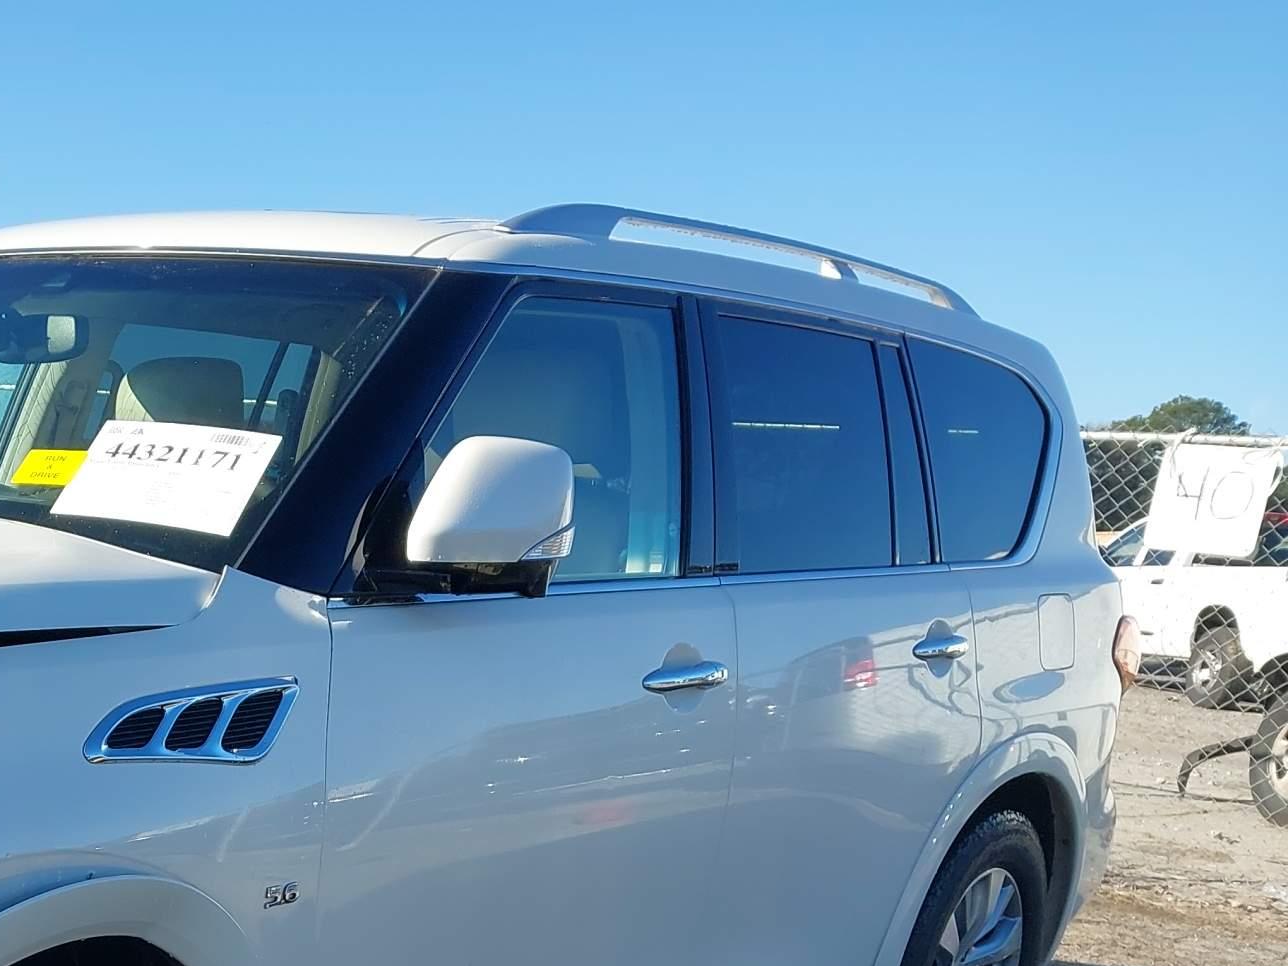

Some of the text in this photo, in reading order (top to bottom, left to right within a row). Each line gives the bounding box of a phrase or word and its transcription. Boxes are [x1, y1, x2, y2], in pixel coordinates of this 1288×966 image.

[44, 455, 69, 463] RUN
[105, 442, 242, 471] 44321171
[29, 471, 62, 479] DRIVE
[1176, 466, 1255, 521] 40
